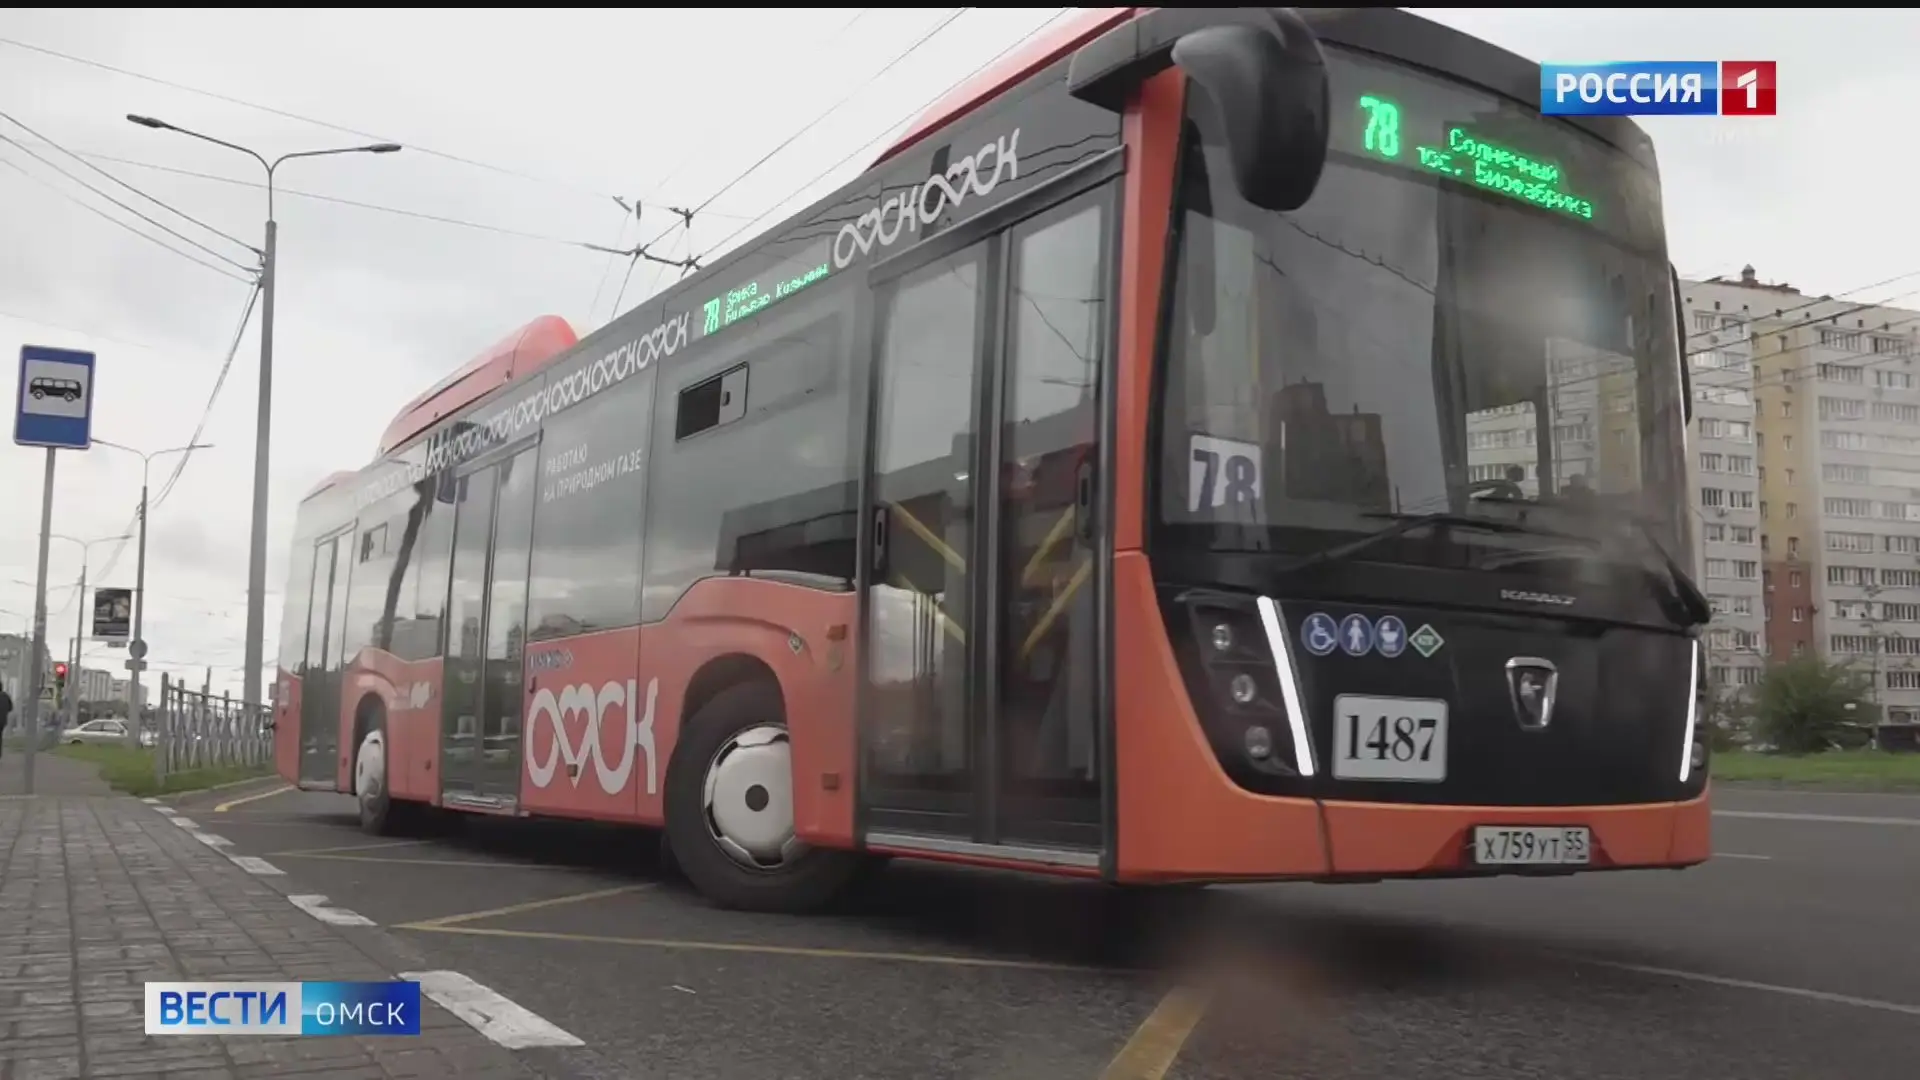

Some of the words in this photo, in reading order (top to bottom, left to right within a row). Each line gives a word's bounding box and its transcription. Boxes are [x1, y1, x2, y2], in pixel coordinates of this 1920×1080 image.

[1360, 96, 1398, 156] 78
[1450, 128, 1557, 183] Солнечный
[1475, 159, 1593, 219] Биофабрика
[545, 443, 588, 478] РАБОТАЮ
[556, 459, 616, 500] ПРИРОДНОМ
[616, 447, 642, 477] ГАЗЕ
[1194, 449, 1256, 511] 78
[1345, 714, 1438, 762] 1487
[1564, 830, 1585, 851] 55
